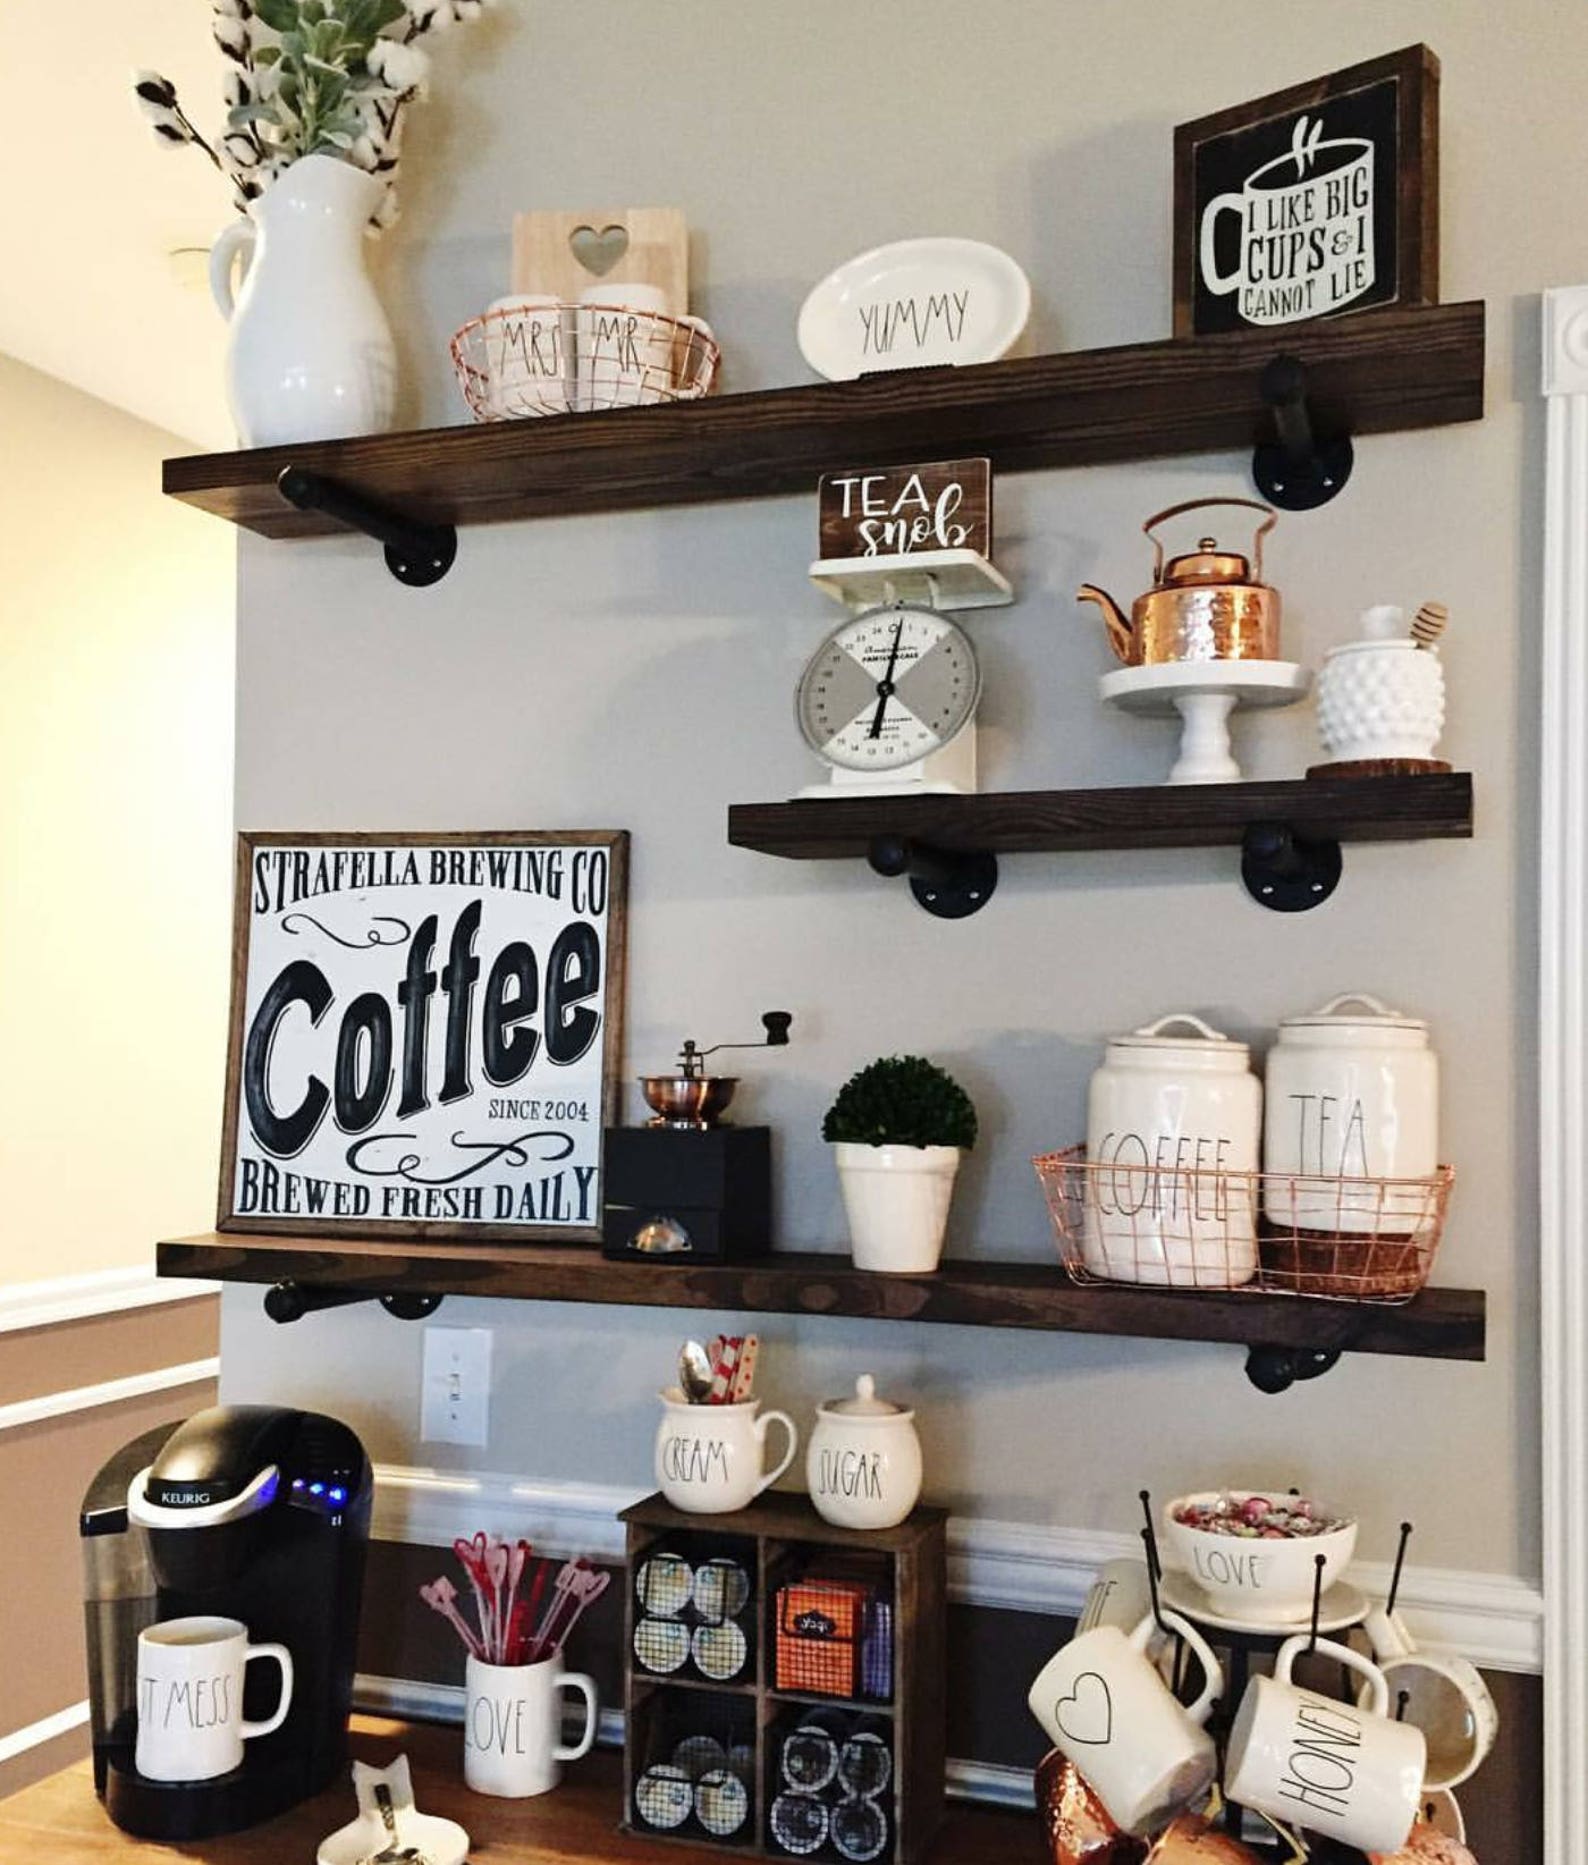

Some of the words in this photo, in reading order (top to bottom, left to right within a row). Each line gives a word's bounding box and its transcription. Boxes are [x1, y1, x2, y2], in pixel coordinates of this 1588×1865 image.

[1248, 200, 1255, 233] I
[1267, 188, 1315, 231] LIKE
[1325, 166, 1369, 220] BIG
[1248, 226, 1326, 283] CUPS
[1330, 230, 1354, 256] &
[1357, 215, 1366, 254] I
[1244, 280, 1315, 318] CANNOT
[1330, 259, 1366, 301] LIE
[500, 320, 560, 376] MRS
[592, 316, 641, 375] MR
[859, 290, 969, 355] YUMMY
[830, 473, 930, 518] TEA
[858, 483, 974, 557] snob
[254, 850, 422, 914] STRAFELLA
[429, 850, 565, 900] BREWING
[571, 850, 608, 915] CO
[244, 899, 602, 1159] Coffee
[488, 1100, 541, 1120] SINCE
[544, 1100, 590, 1122] 2004
[238, 1158, 370, 1217] BREWED
[381, 1187, 483, 1220] FRESH
[494, 1166, 598, 1222] DAILY
[1098, 1132, 1231, 1221] COFFEE
[663, 1435, 729, 1483] CREAM
[818, 1449, 883, 1500] SUGAR
[161, 1491, 210, 1504] KEURIG
[1193, 1545, 1262, 1589] LOVE
[163, 1673, 231, 1728] MESS
[1278, 1696, 1361, 1818] HONEY
